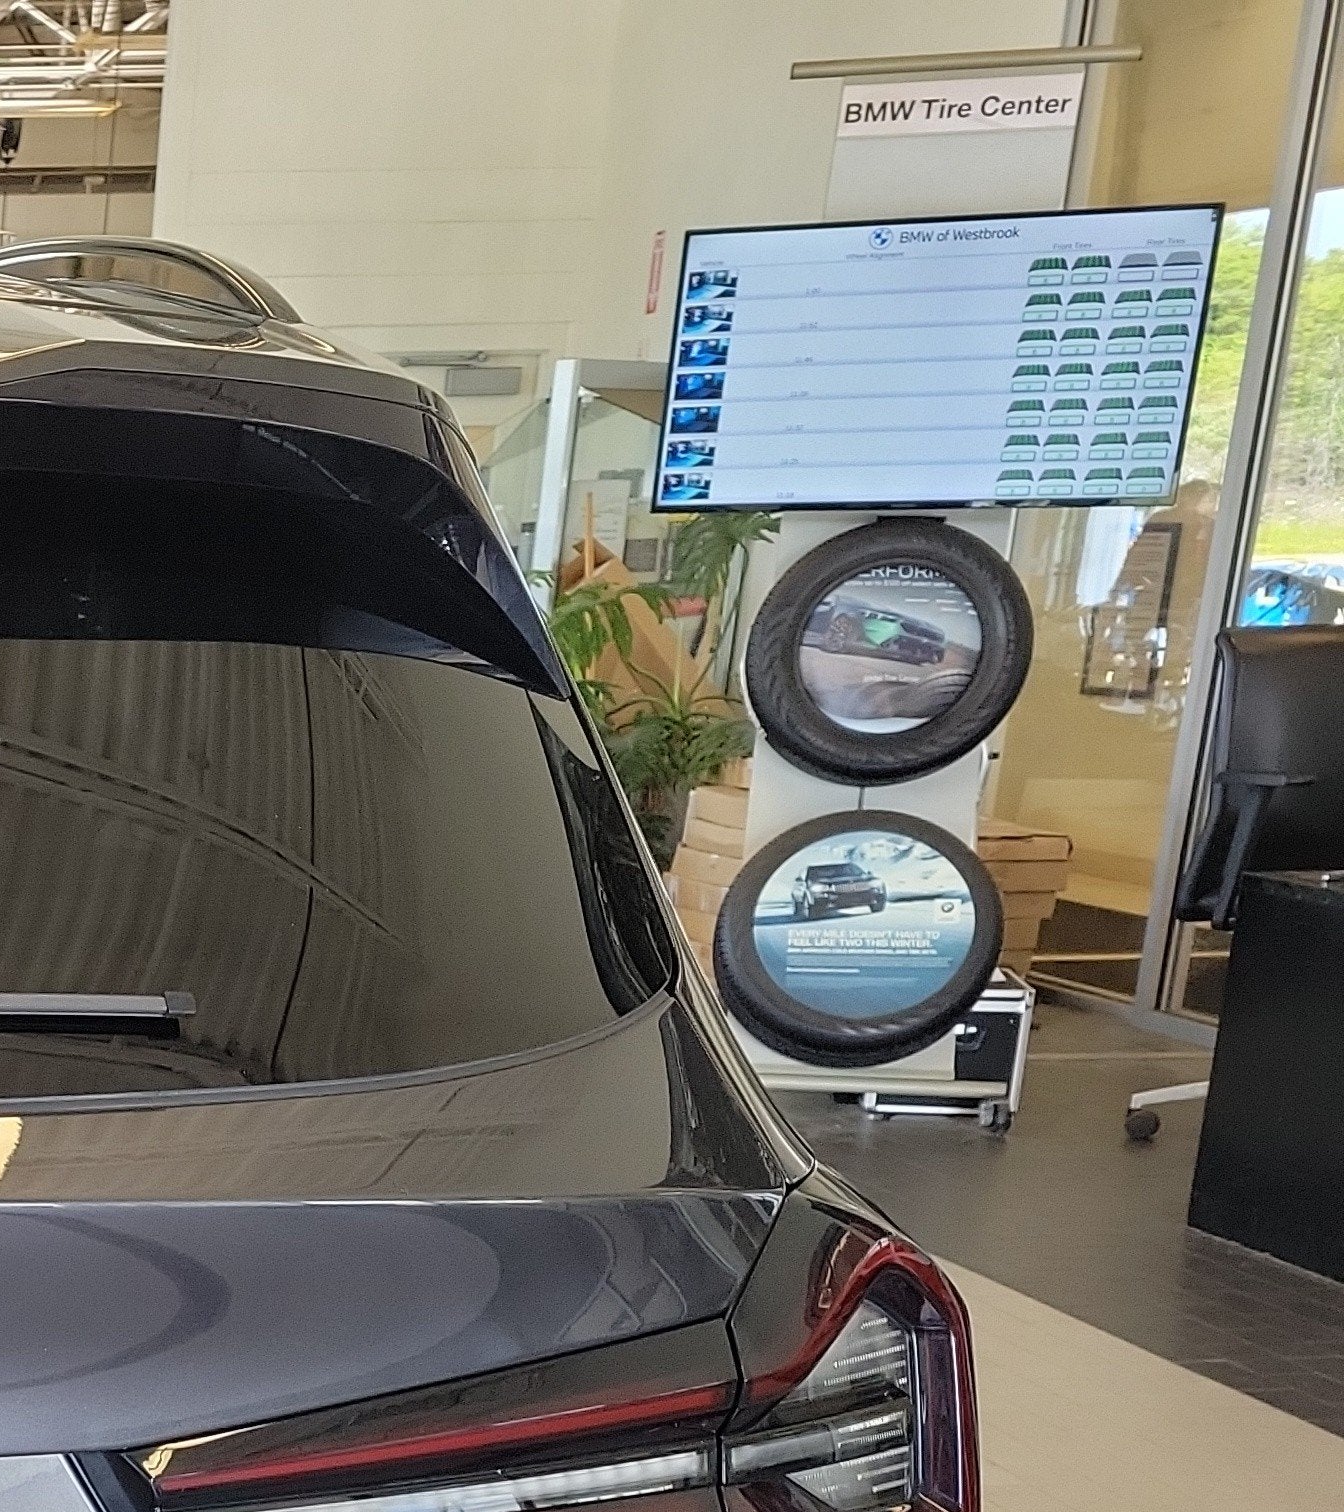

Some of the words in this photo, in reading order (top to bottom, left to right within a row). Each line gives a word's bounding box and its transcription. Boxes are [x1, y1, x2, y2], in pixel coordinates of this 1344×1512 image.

[844, 100, 915, 123] BMW
[922, 98, 972, 119] Tire
[980, 95, 1072, 117] Center
[899, 231, 934, 243] BMW
[937, 230, 950, 242] of
[953, 226, 1020, 241] Westbrook
[814, 938, 837, 946] LIKE
[840, 939, 863, 947] TWO
[866, 939, 889, 947] THIS
